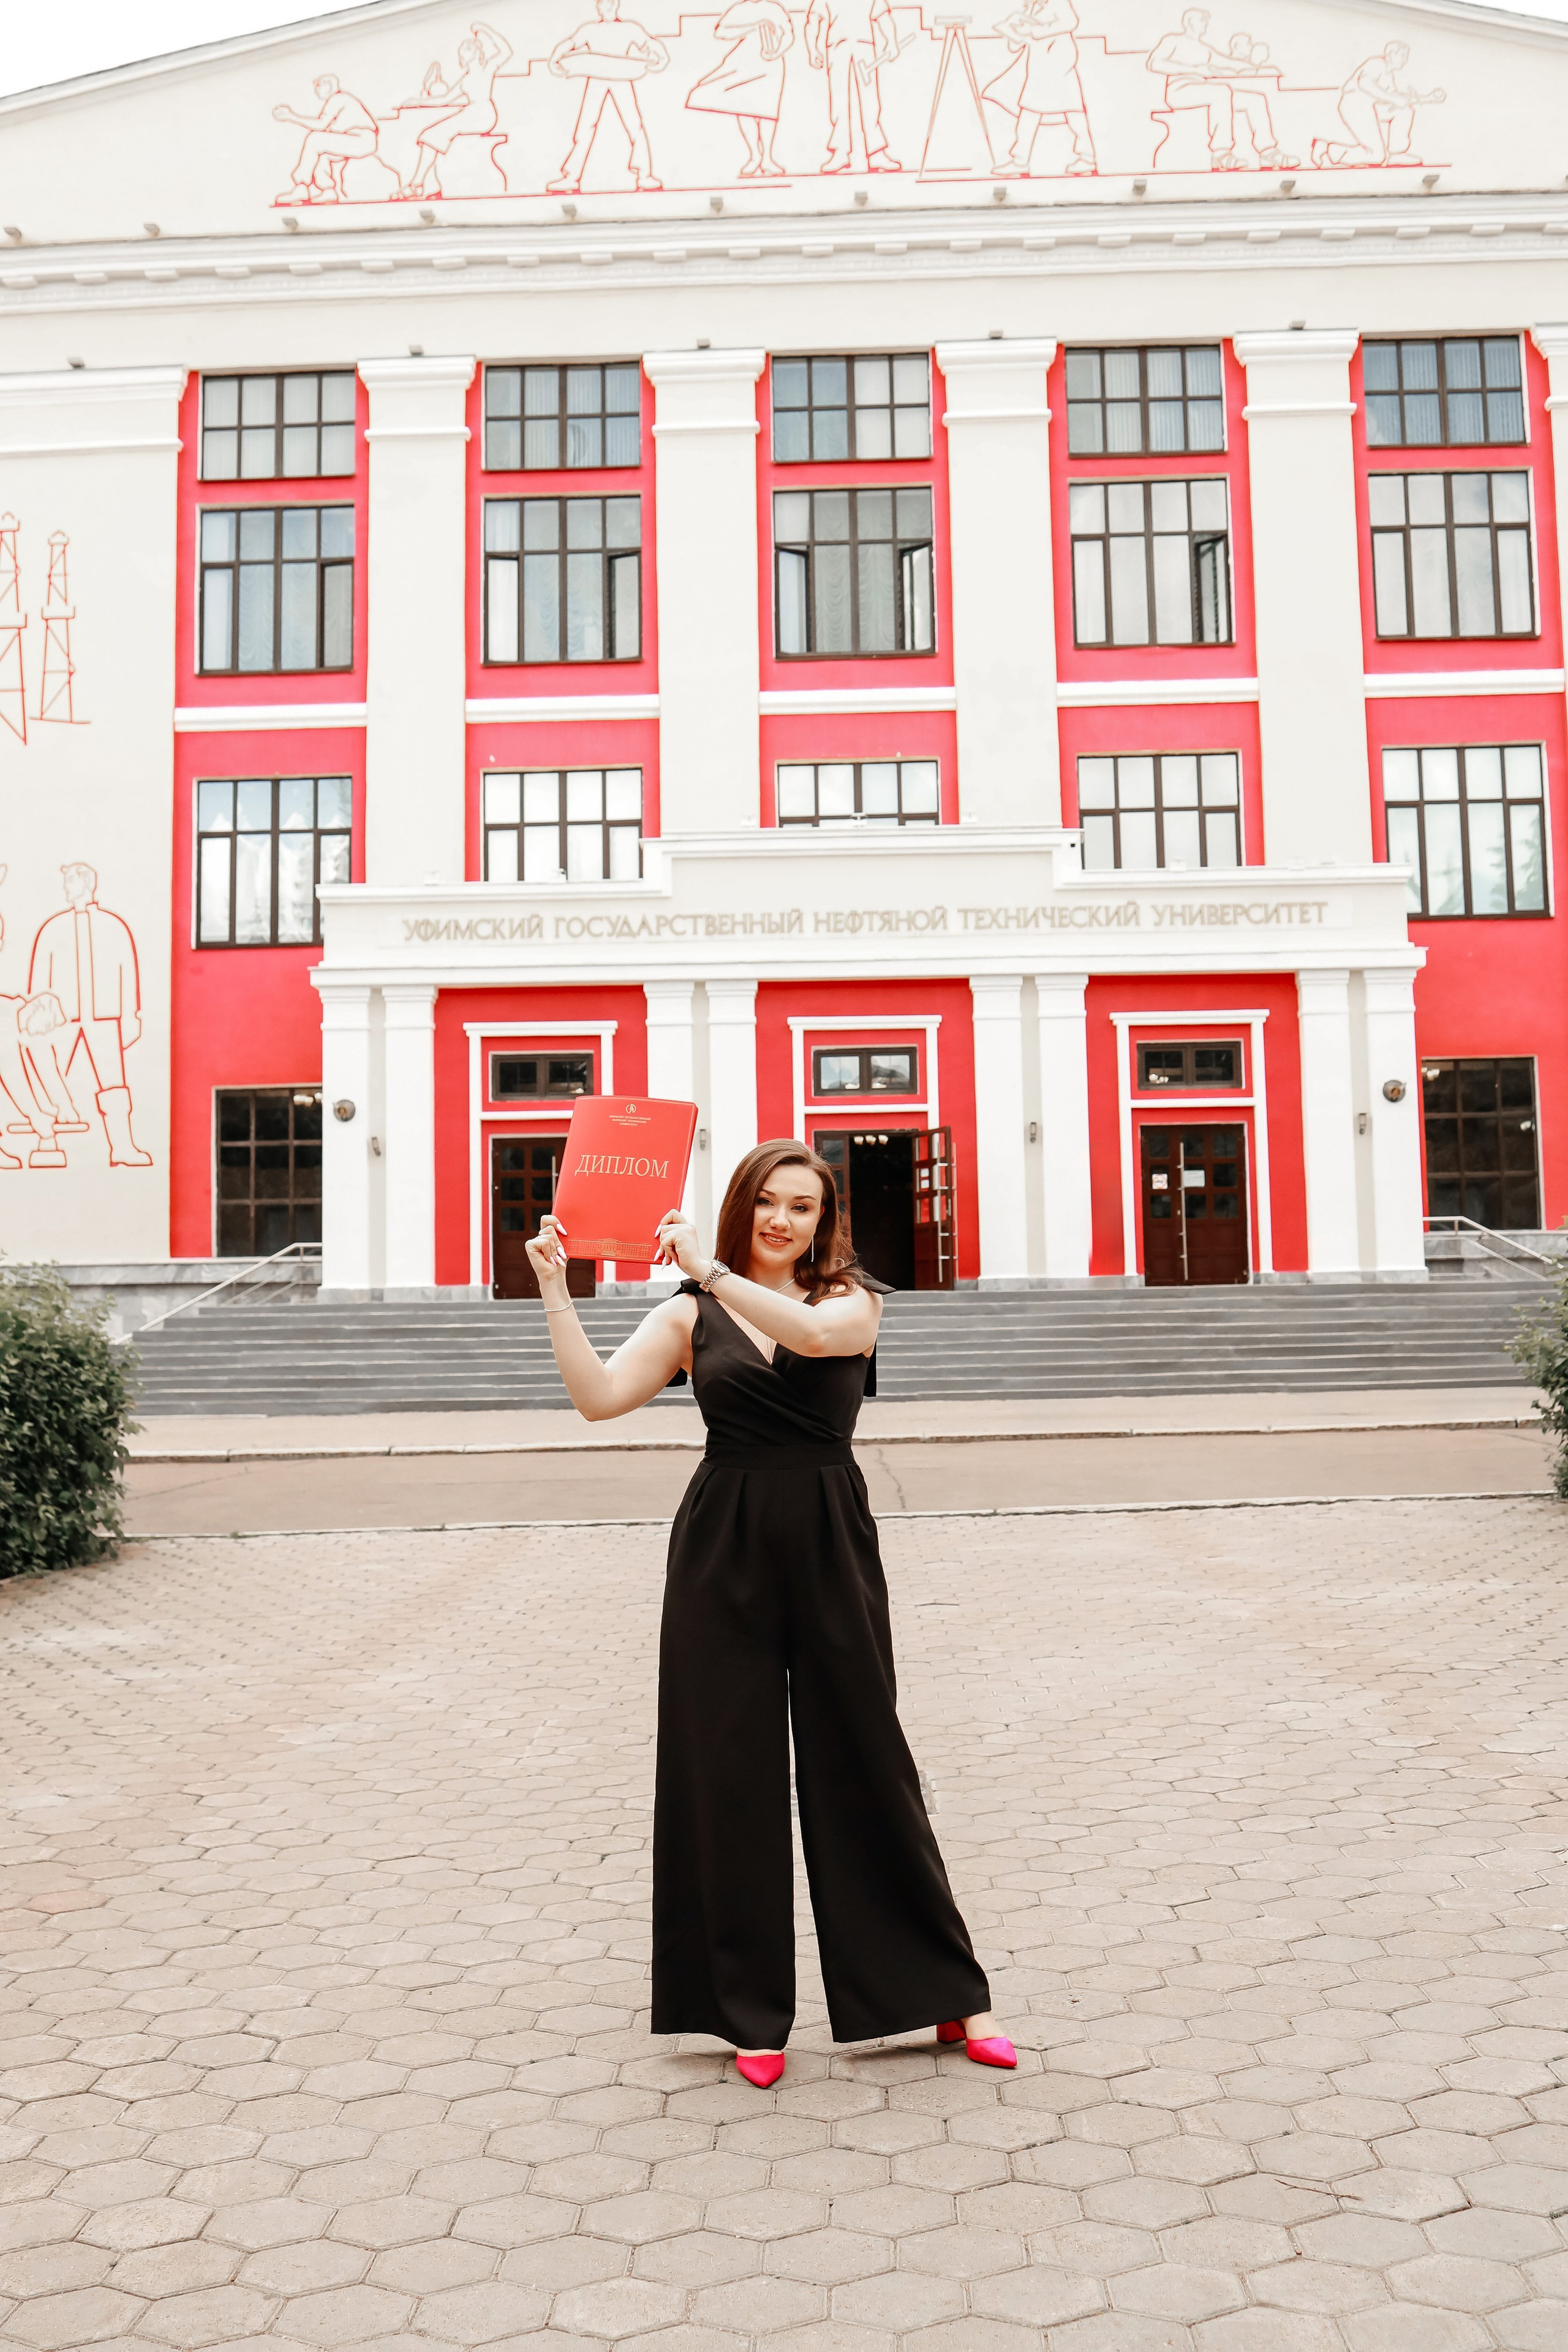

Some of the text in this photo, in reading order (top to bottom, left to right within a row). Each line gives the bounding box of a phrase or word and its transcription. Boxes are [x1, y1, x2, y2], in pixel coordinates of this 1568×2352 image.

[403, 900, 1329, 942] УФИМСКИЙ ГОСУДАРСТВЕННЫЙ НЕФТЯНОЙ ТЕХНИЧЕСКИЙ УНИВЕРСИТЕТ
[575, 1155, 670, 1178] ДИПЛОМ
